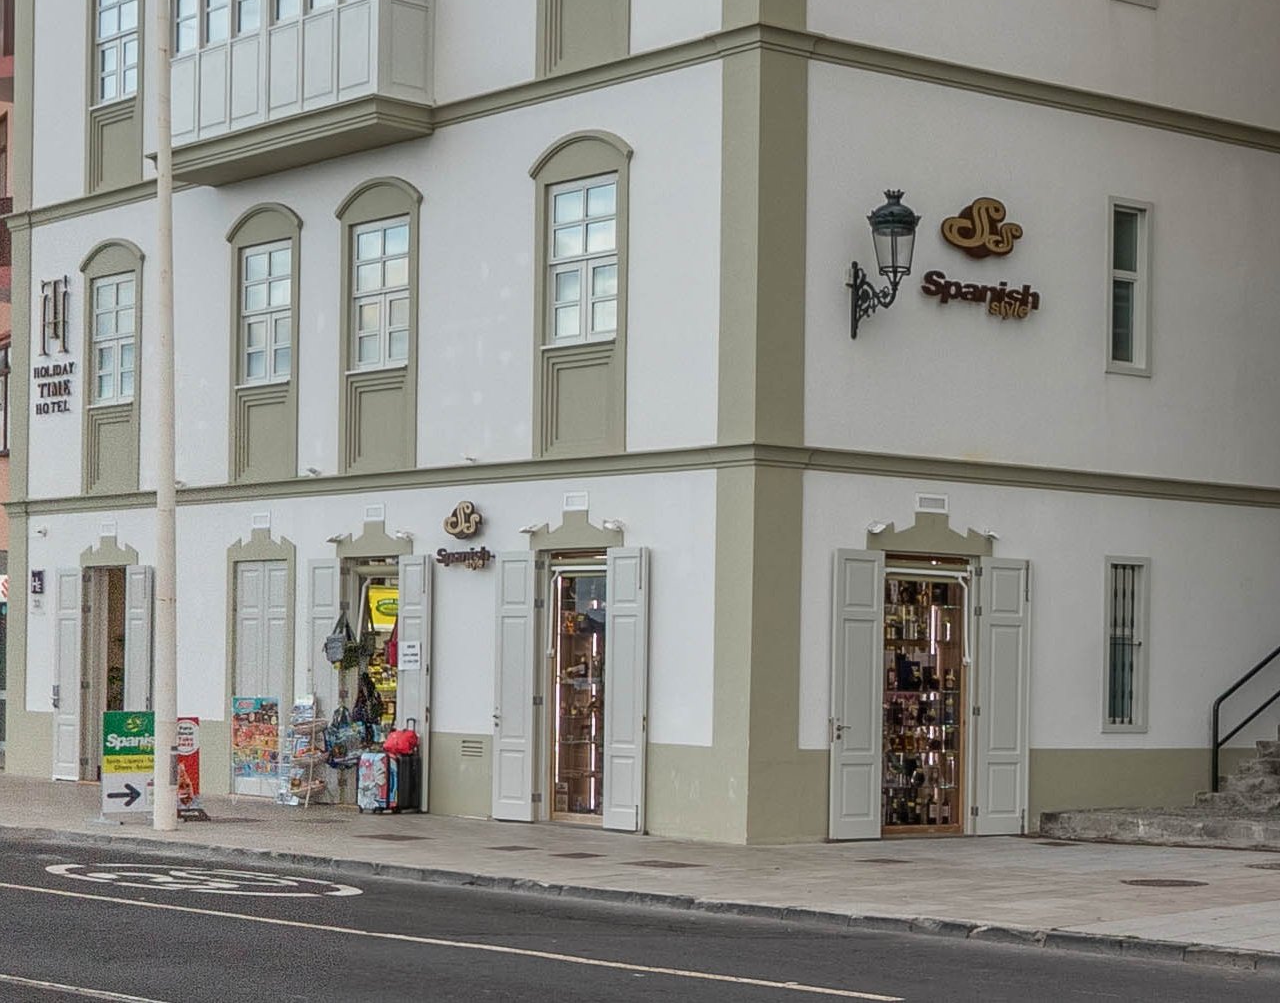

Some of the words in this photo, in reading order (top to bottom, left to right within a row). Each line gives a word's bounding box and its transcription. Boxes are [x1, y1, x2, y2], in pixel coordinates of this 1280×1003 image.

[921, 270, 1040, 311] Spanish
[989, 300, 1031, 320] style
[33, 362, 76, 380] HOLIDAY
[37, 379, 72, 399] TIME
[35, 400, 71, 416] HOTEL
[436, 546, 491, 567] Spanish
[106, 733, 155, 751] Spanis
